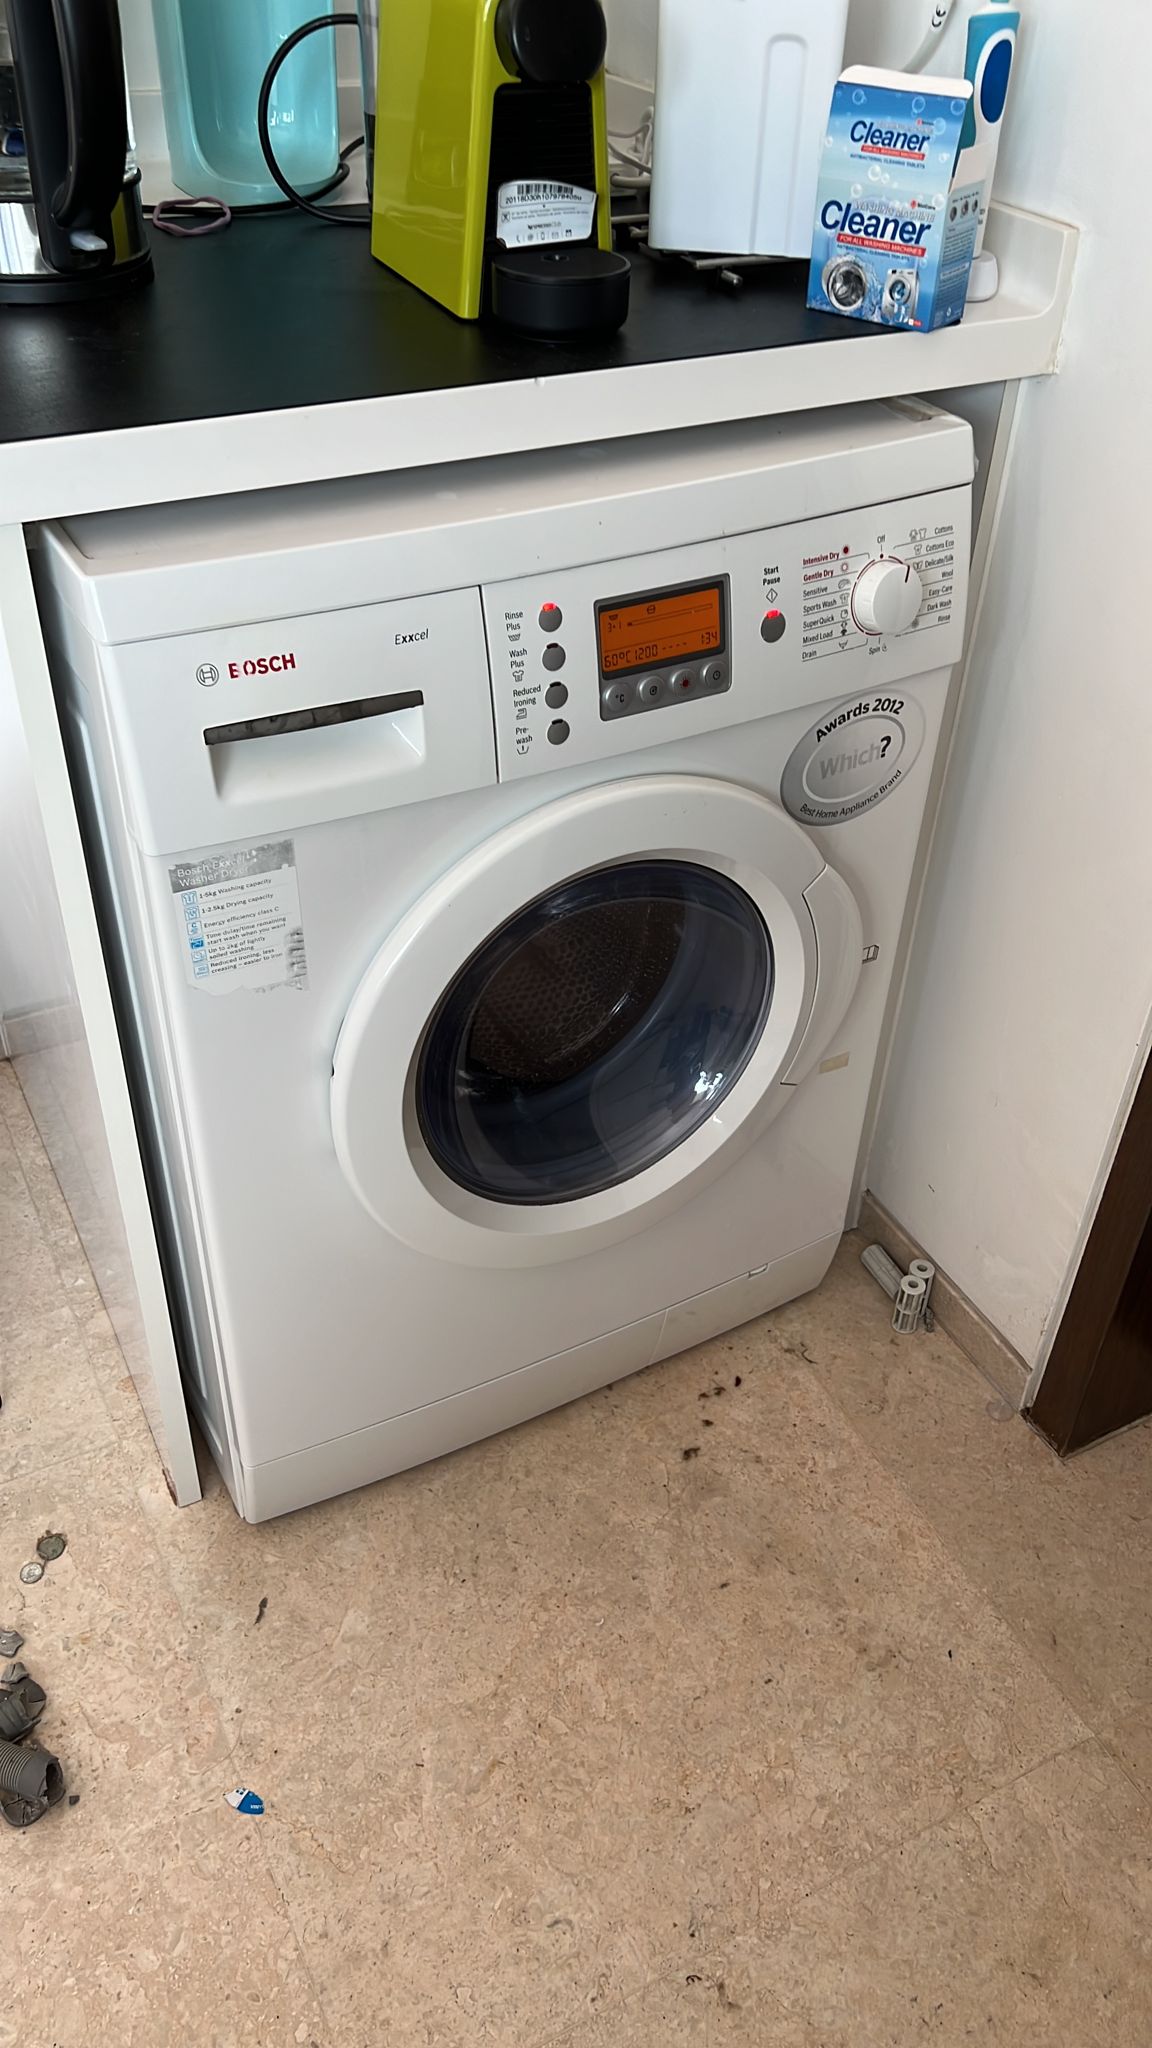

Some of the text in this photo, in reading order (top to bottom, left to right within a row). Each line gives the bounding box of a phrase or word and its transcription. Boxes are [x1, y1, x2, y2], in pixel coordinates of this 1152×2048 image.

[850, 120, 930, 151] Cleaner
[821, 200, 932, 245] Cleaner
[877, 534, 886, 544] Off
[926, 540, 954, 552] Cottons Eco
[802, 552, 840, 566] Intensive Dry
[924, 554, 954, 568] Delicate/Silk
[764, 566, 778, 576] Start
[804, 569, 834, 582] Gentle Dry
[942, 570, 953, 578] Wool
[762, 576, 780, 586] Pause
[803, 586, 828, 598] Sensitive
[803, 598, 836, 614] Sports Wash
[927, 599, 952, 612] Dark Wash
[504, 610, 524, 620] Rinse
[938, 614, 950, 622] Rinse
[506, 622, 521, 631] Plus
[394, 628, 429, 645] Exxcel
[802, 630, 834, 644] Mixed Load
[508, 648, 528, 658] Wash
[634, 644, 658, 660] 1200
[802, 649, 817, 660] Drain
[868, 646, 880, 656] Spin
[510, 660, 524, 668] Plus
[512, 684, 542, 697] Reduced
[514, 696, 536, 708] Ironing
[816, 698, 904, 742] Awards 2012
[516, 726, 529, 736] Pre-
[516, 734, 533, 744] wash
[820, 735, 892, 780] Which?
[800, 769, 902, 818] Best Home Appliance Brand
[177, 862, 210, 878] Bosch
[178, 872, 218, 887] Washer
[218, 884, 244, 894] Washing
[246, 878, 272, 888] capacity
[226, 898, 247, 909] Drying
[248, 892, 274, 904] capacity
[204, 918, 226, 928] Energy
[226, 911, 256, 924] efficiency
[257, 907, 273, 916] class
[206, 930, 222, 939] Time
[256, 916, 286, 927] remaining
[207, 923, 286, 946] start wash when you want
[246, 936, 266, 945] lightly
[209, 945, 254, 960] soiled washing
[210, 956, 238, 968] Reduced
[211, 963, 238, 974] creasing
[243, 957, 262, 966] easier
